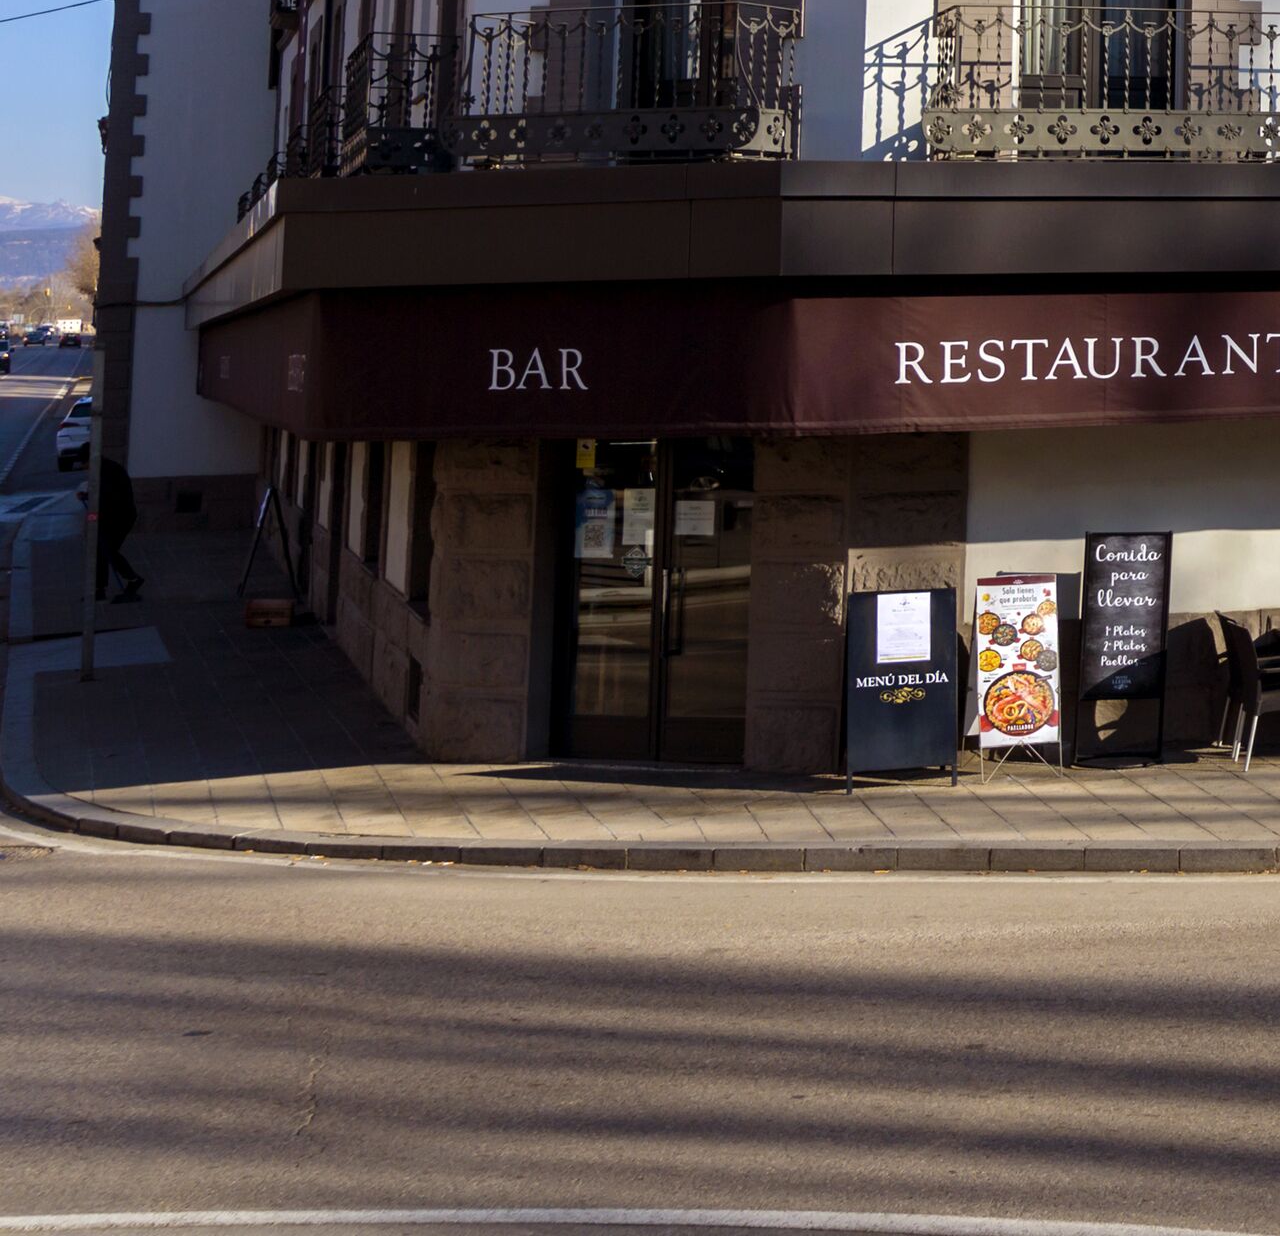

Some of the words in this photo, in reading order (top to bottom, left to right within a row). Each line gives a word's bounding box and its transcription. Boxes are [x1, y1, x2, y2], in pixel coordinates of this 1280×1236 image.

[488, 347, 589, 391] BAR
[1095, 543, 1162, 562] Comida
[1111, 571, 1149, 587] para
[1097, 589, 1157, 607] llevar
[1113, 624, 1148, 637] Platos
[1113, 639, 1148, 652] Platos
[856, 672, 896, 688] MENÚ
[898, 673, 924, 685] DEL
[925, 669, 949, 683] DÍA
